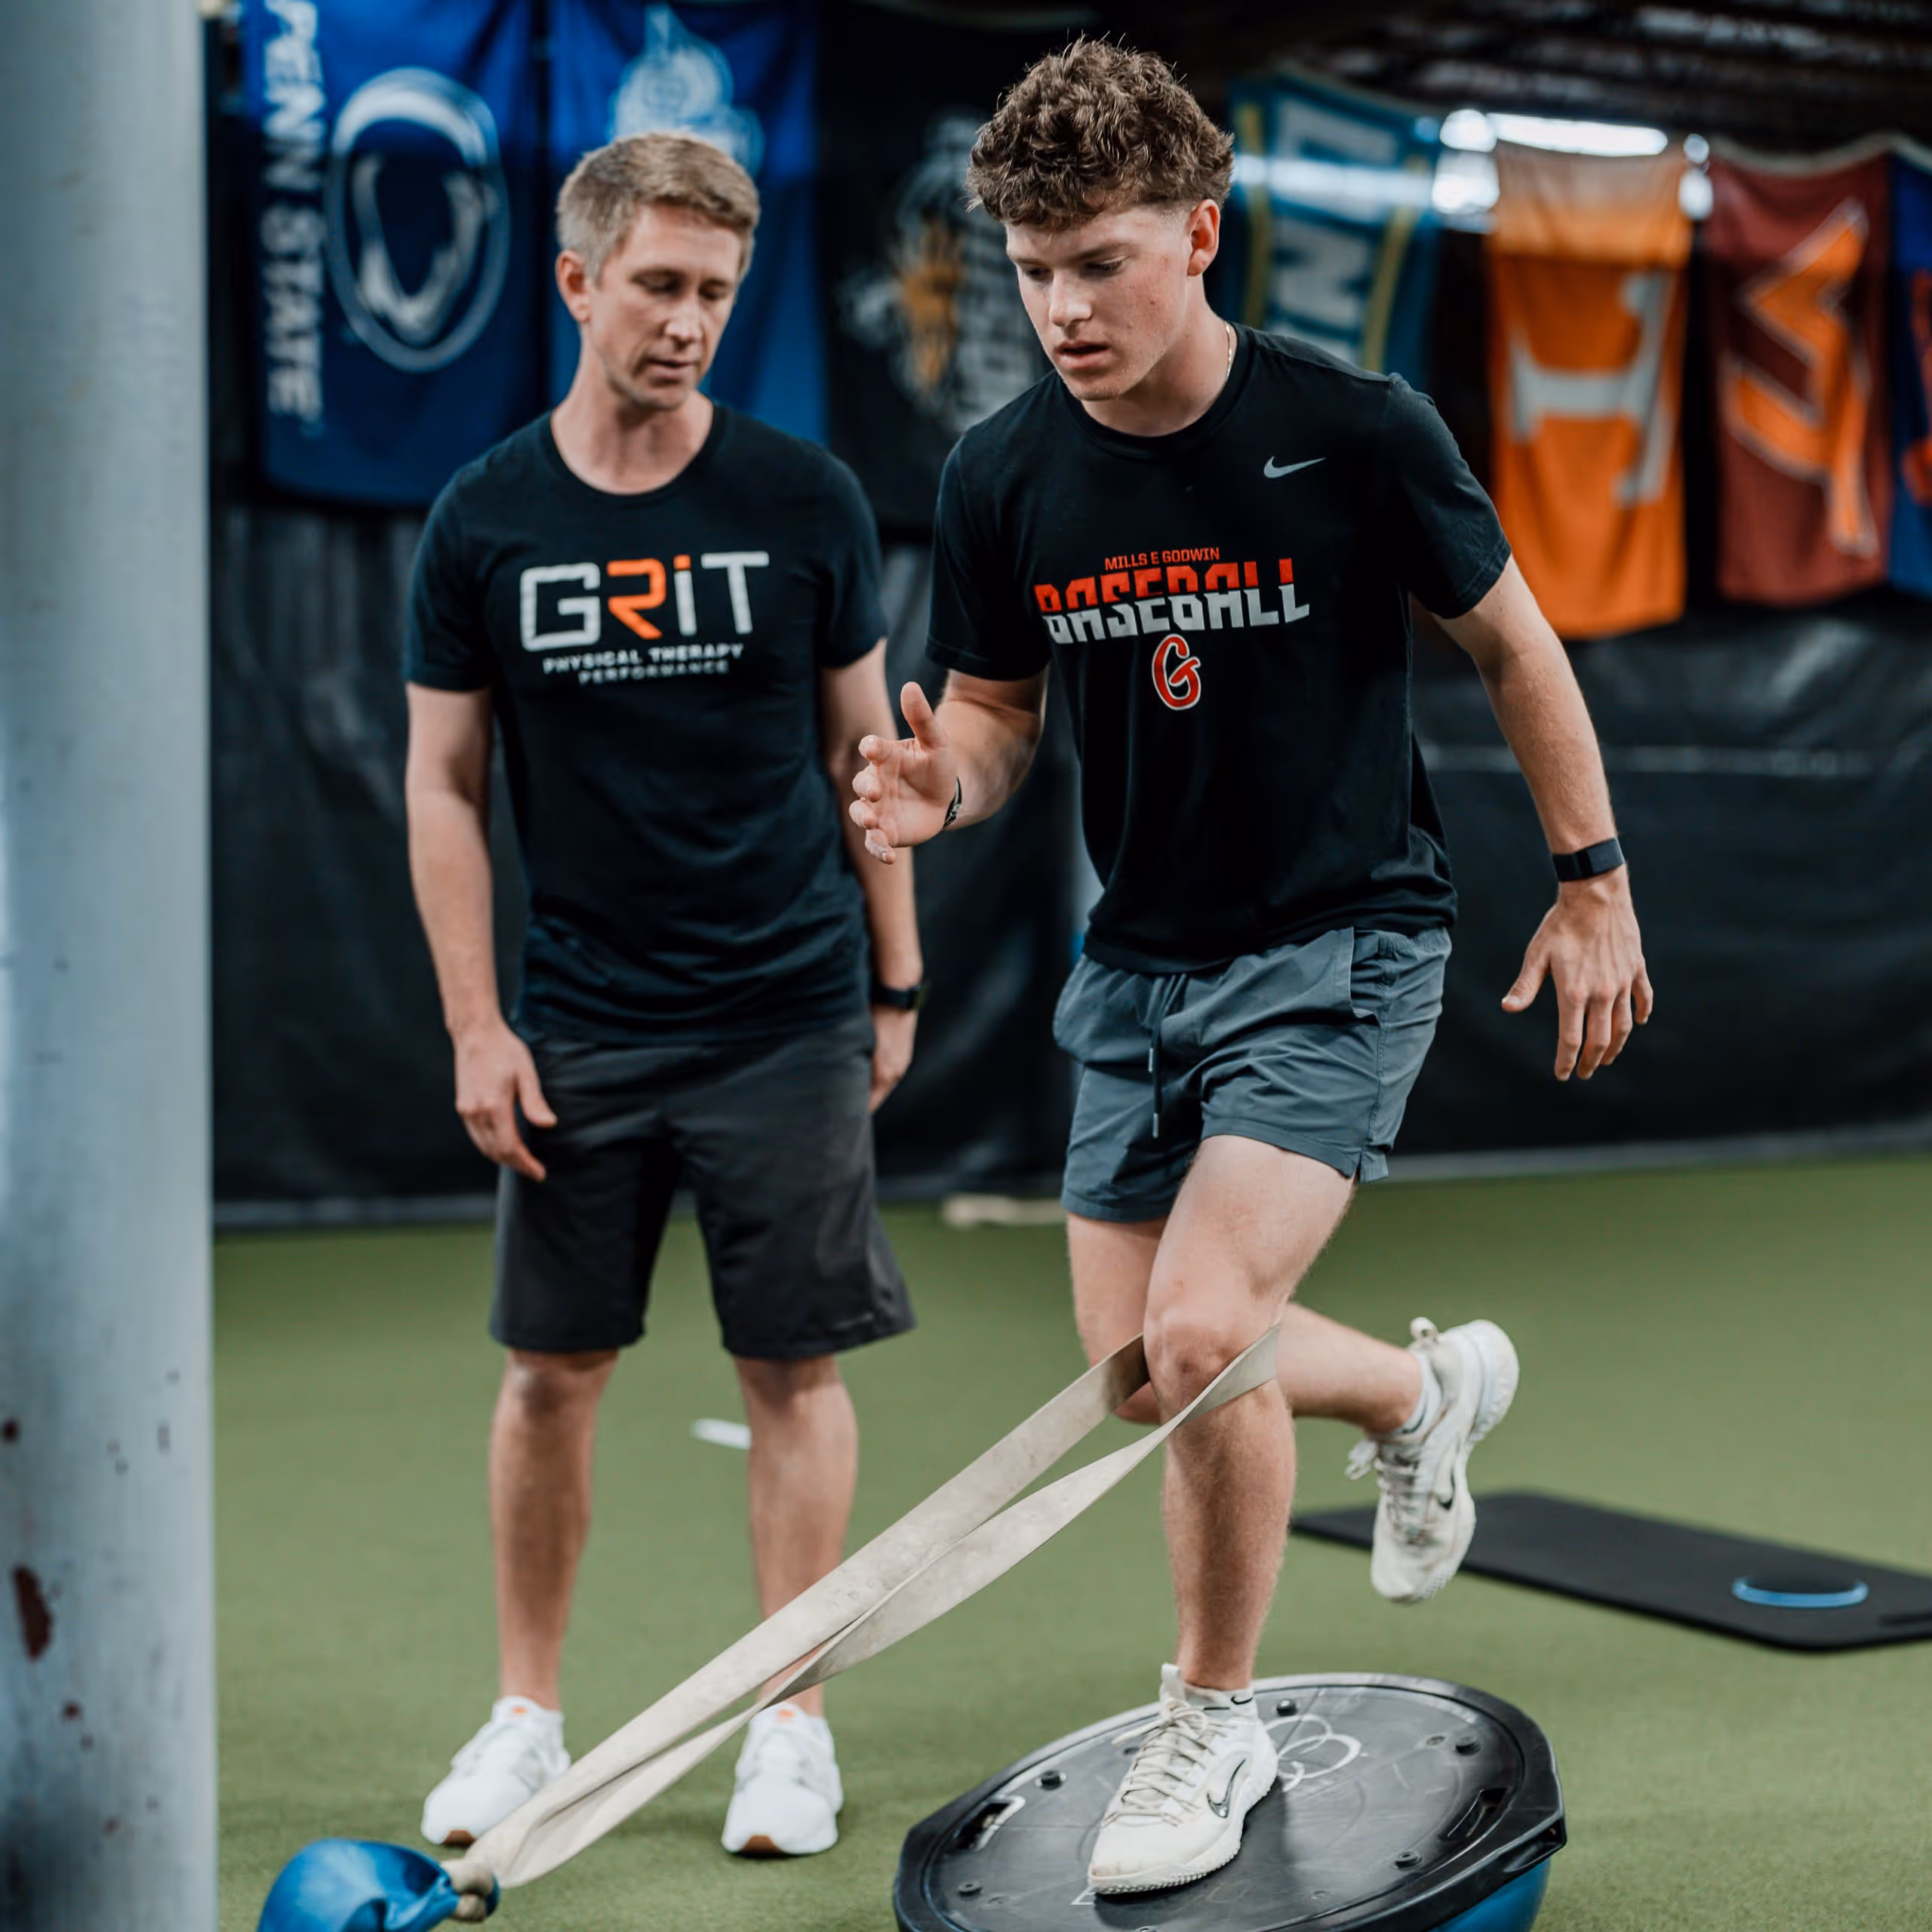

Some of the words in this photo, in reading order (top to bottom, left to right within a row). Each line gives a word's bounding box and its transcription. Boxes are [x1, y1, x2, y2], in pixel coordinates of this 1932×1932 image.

[263, 0, 325, 191] PENN
[262, 205, 323, 419] STATE
[1105, 552, 1147, 571] MILLS
[1150, 551, 1159, 565] E
[1162, 547, 1220, 564] GODWIN
[1034, 558, 1310, 644] BASEBALL
[543, 649, 642, 675] PHYSICAL
[648, 643, 743, 663] THERAPY
[578, 659, 729, 685] PERFORMANCE
[1152, 633, 1201, 711] G
